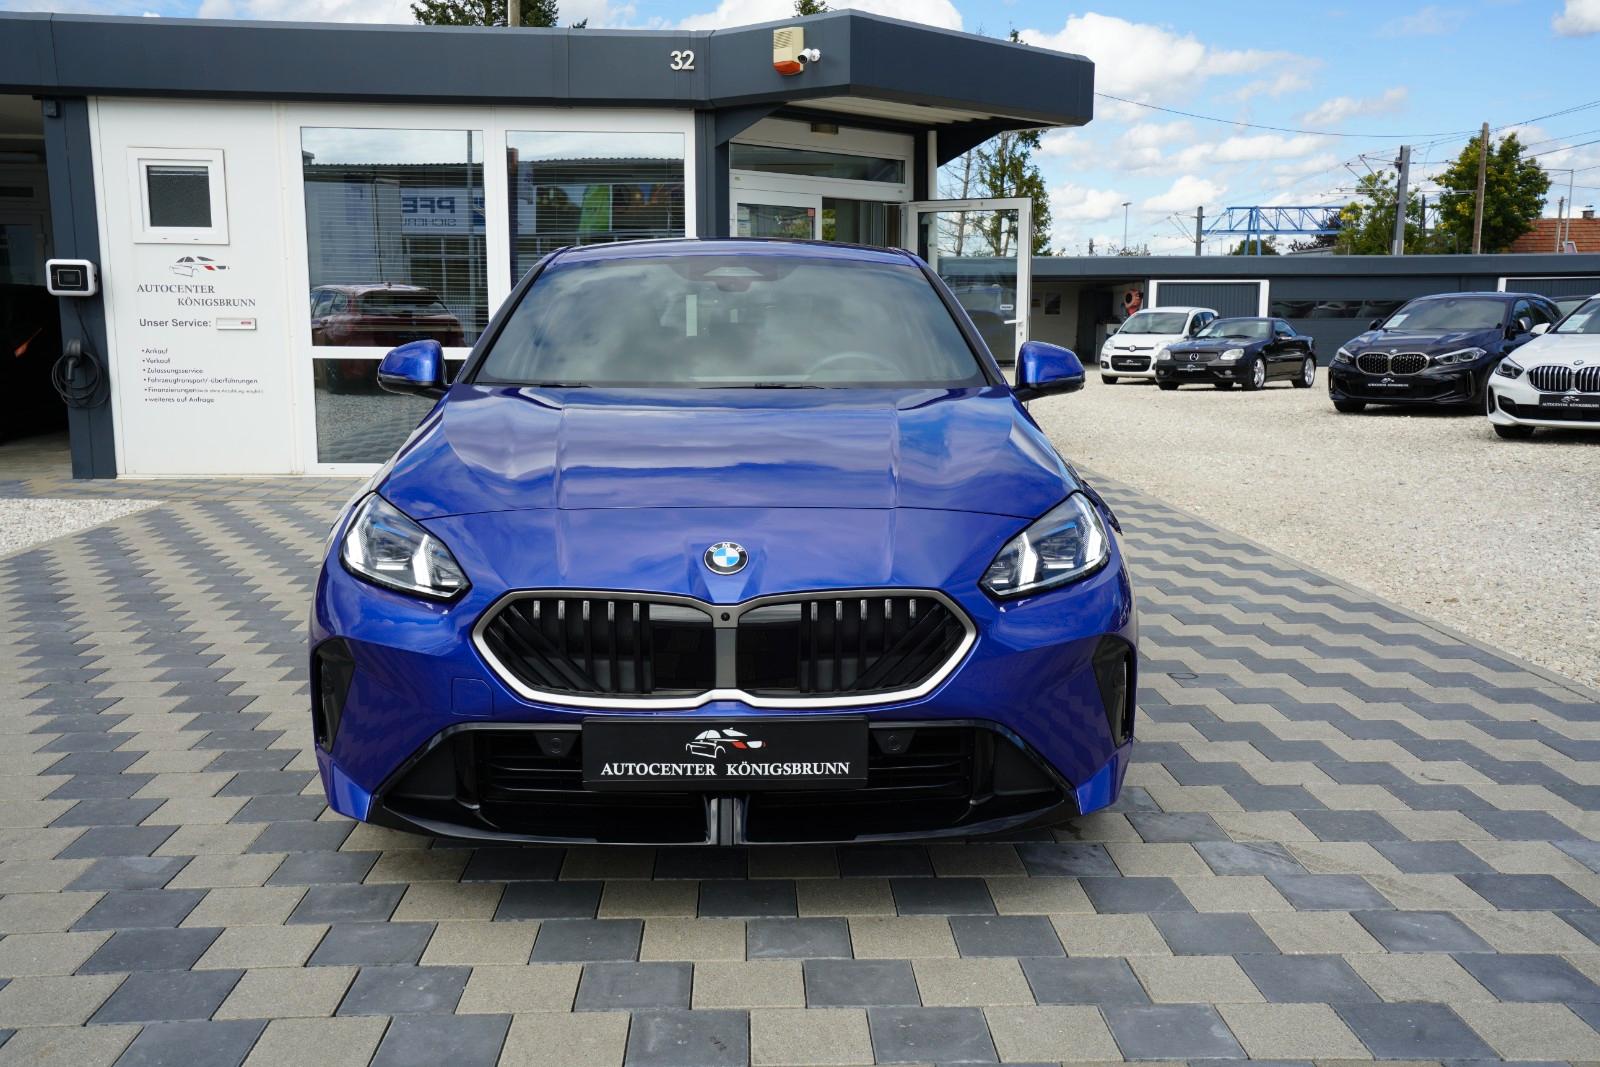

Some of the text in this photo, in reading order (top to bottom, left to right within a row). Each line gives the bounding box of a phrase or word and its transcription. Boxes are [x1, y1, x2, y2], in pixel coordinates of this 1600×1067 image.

[670, 50, 695, 71] 32
[136, 284, 215, 294] AUTOCENTER
[177, 297, 256, 307] KÖNIGSBRUNN
[139, 318, 212, 327] Unser Service:
[189, 396, 215, 404] Anfrage
[709, 543, 745, 553] BMW
[600, 761, 850, 777] AUTOCENTER KÖNIGSBRUNN
